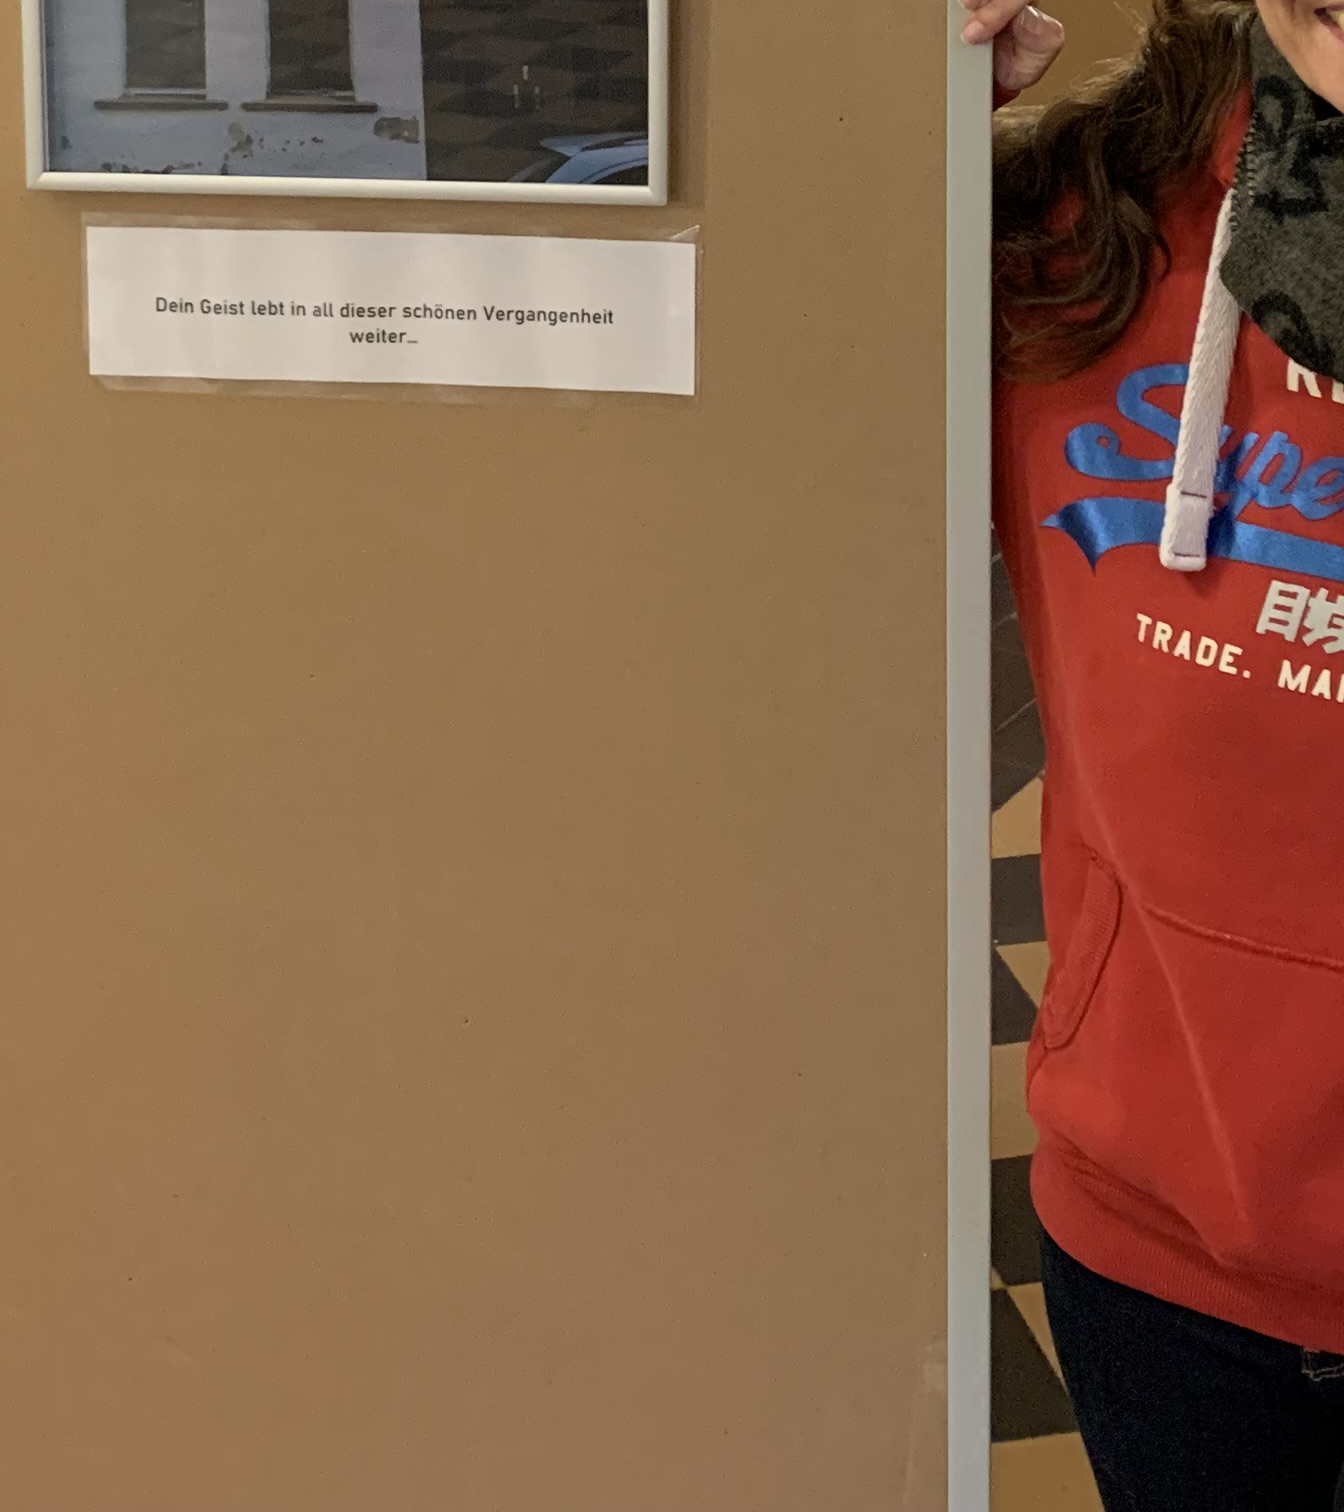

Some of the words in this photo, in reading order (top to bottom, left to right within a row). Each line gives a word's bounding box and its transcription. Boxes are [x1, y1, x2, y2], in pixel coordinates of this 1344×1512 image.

[155, 296, 195, 314] Dein
[199, 298, 245, 316] Geist
[251, 299, 286, 316] lebt
[290, 300, 307, 317] in
[312, 302, 334, 318] all
[339, 302, 397, 318] dieser
[402, 303, 477, 321] schönen
[482, 305, 615, 326] Vergangenheit
[1135, 613, 1252, 679] TRADE.
